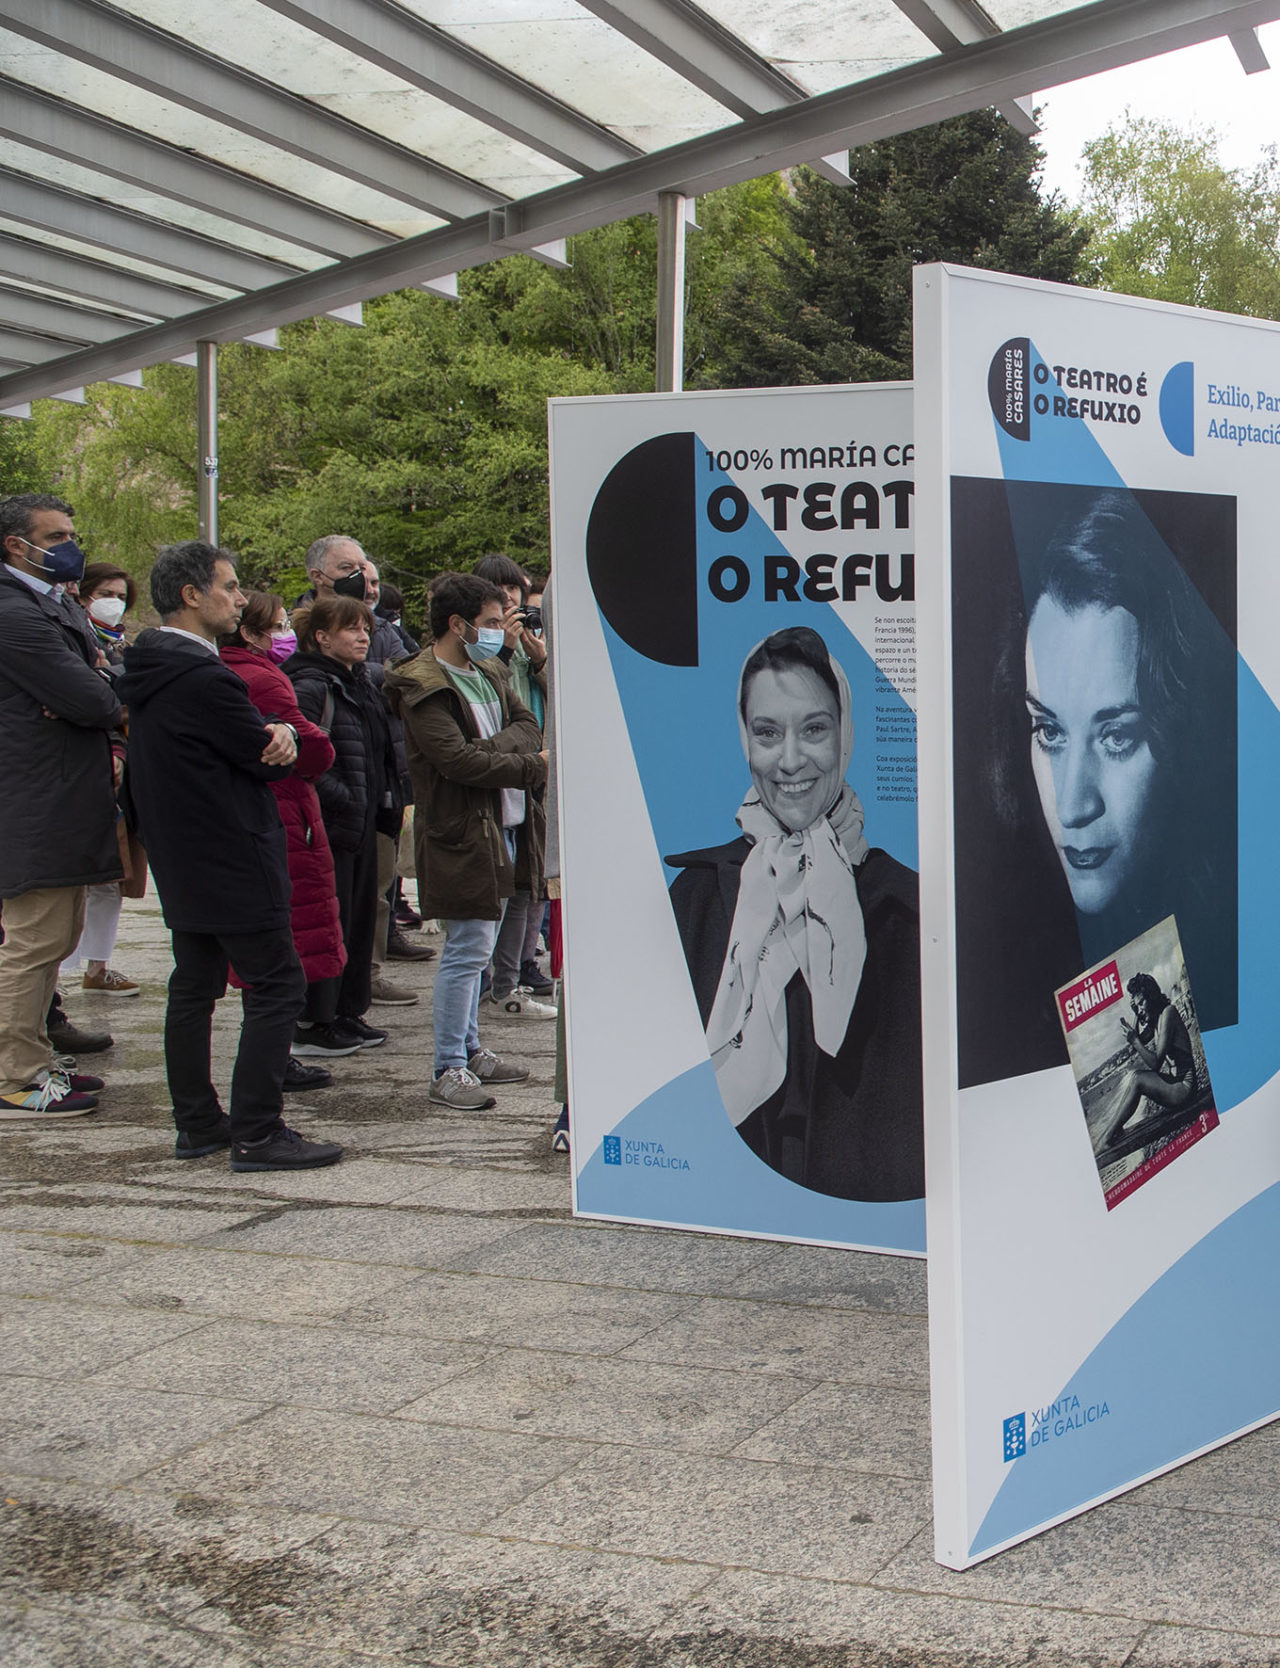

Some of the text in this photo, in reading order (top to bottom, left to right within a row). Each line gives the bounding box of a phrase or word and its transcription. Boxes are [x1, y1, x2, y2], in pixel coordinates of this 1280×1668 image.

[1004, 350, 1013, 391] MARÍA
[1014, 349, 1023, 424] CASARES
[1034, 363, 1148, 397] O TEATRO É
[1034, 394, 1141, 425] O REFUXIO
[1208, 384, 1254, 412] Exilio,
[706, 449, 774, 471] 100%
[780, 441, 876, 469] MARÍA
[707, 480, 915, 533] O TEAT
[708, 554, 915, 602] O REFU
[1065, 973, 1118, 1022] SEMAINE
[1084, 978, 1093, 988] LA
[625, 1140, 665, 1154] XUNTA
[625, 1154, 690, 1170] DE GALICIA
[1031, 1401, 1110, 1447] DE GALICIA
[1032, 1395, 1080, 1427] XUNTA
